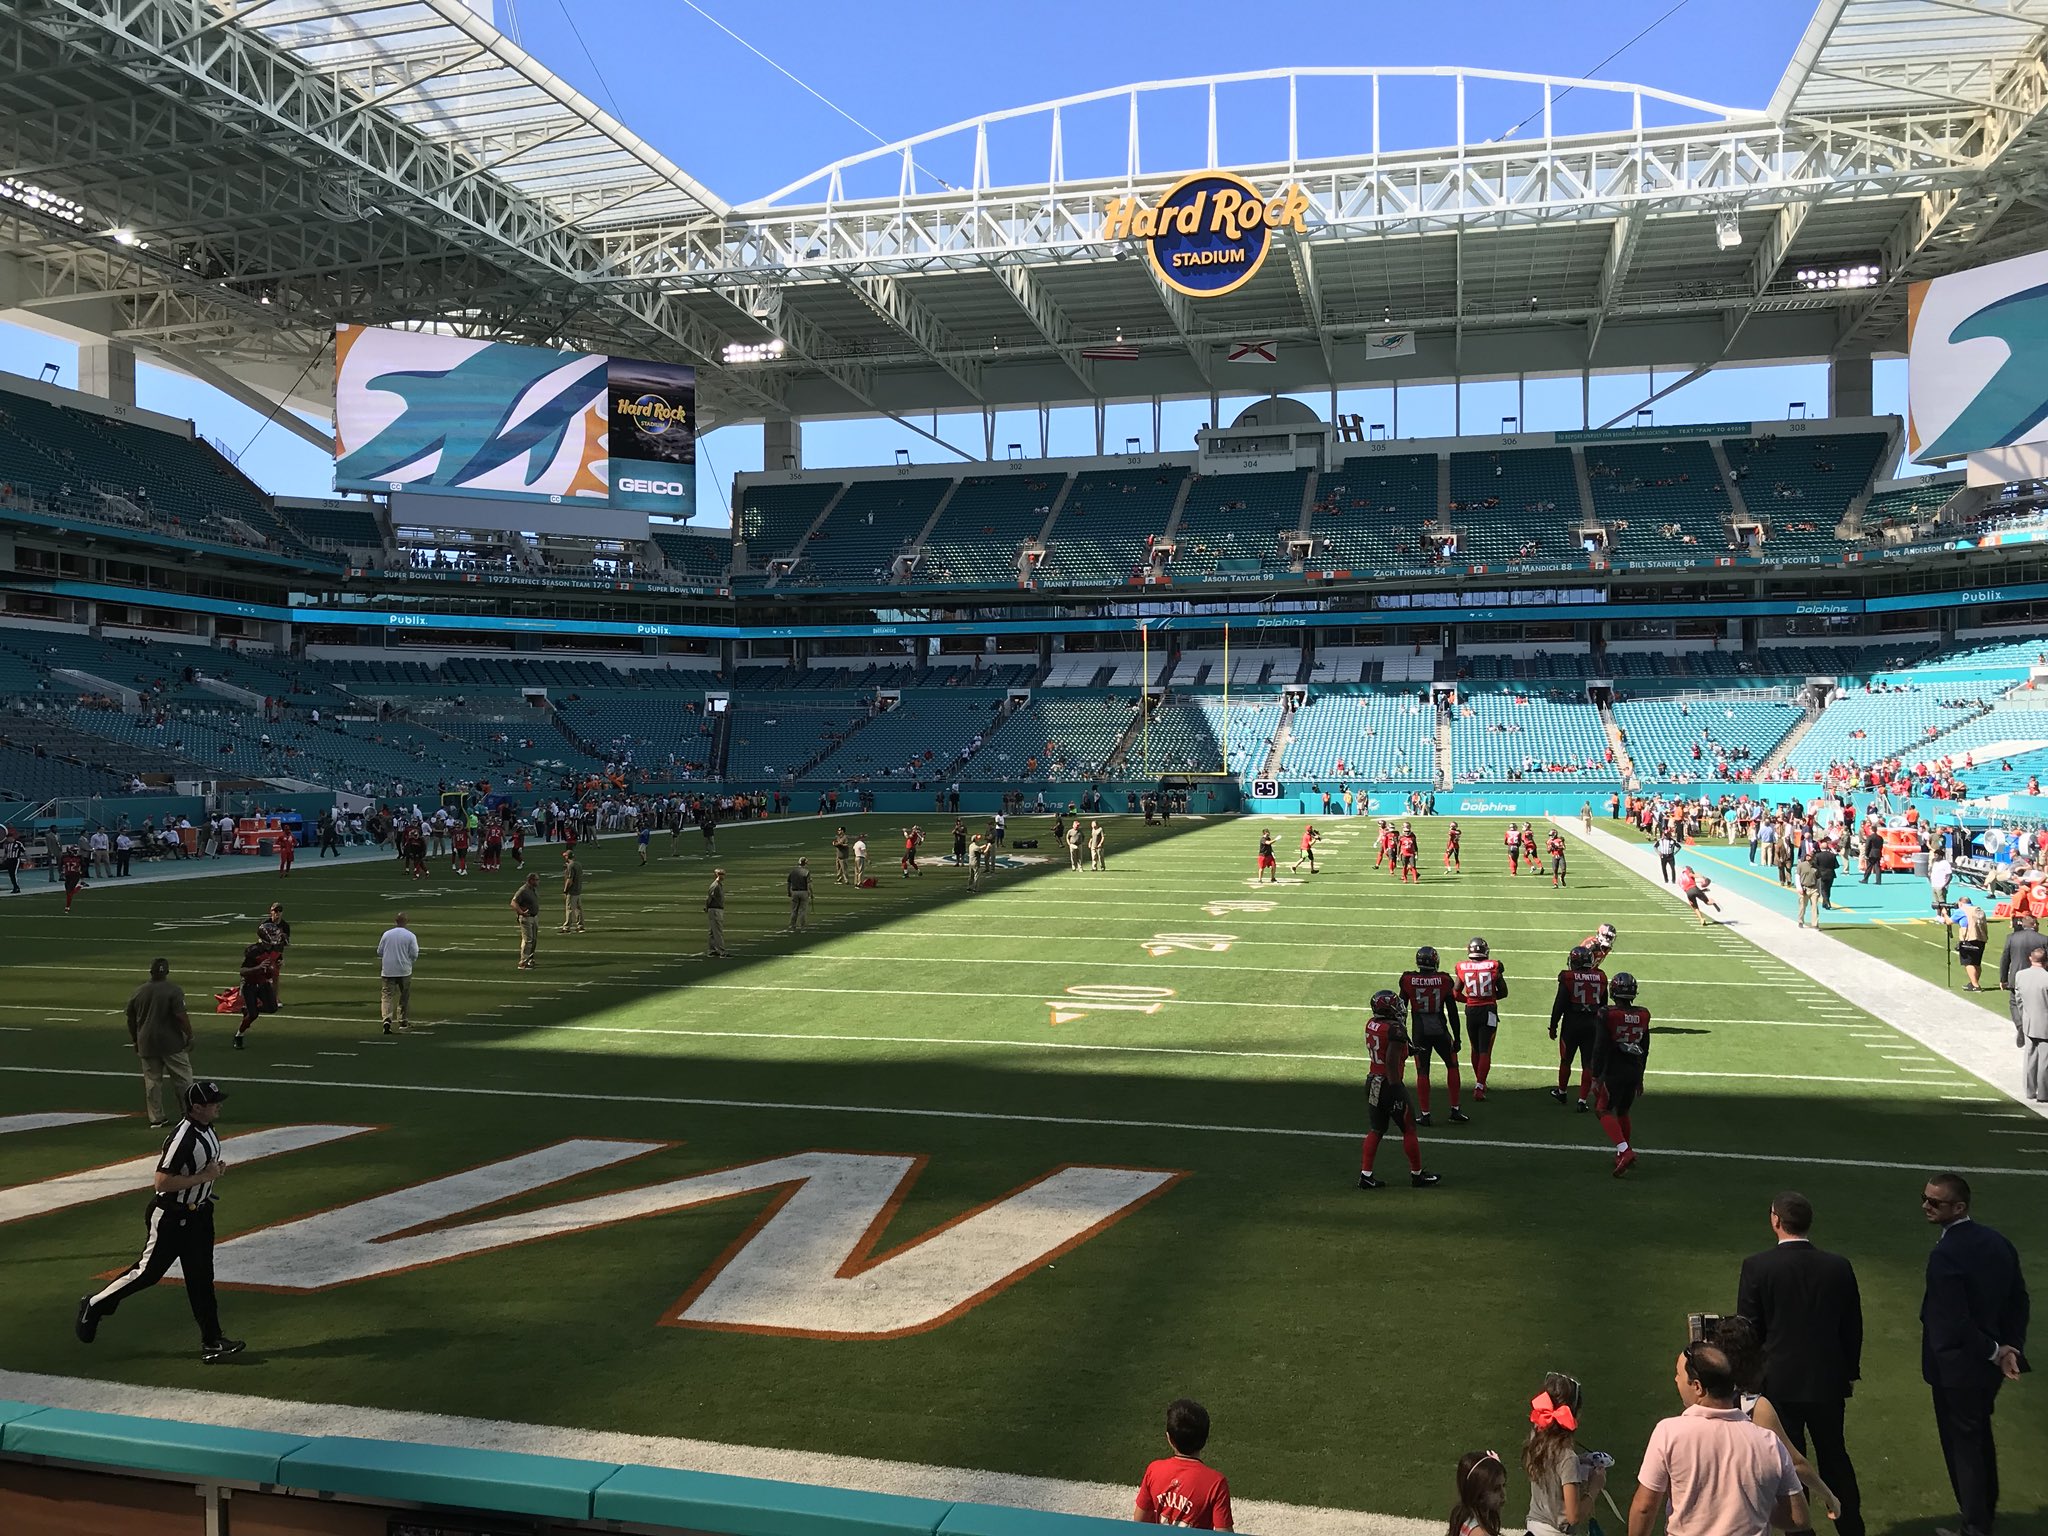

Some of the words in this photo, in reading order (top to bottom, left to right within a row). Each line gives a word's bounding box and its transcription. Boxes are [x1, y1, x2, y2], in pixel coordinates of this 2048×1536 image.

[1104, 191, 1207, 240] Hard
[1210, 183, 1309, 240] Rock
[1172, 248, 1245, 267] STADIUM
[113, 405, 127, 417] 351
[617, 398, 653, 417] Hard
[653, 402, 686, 424] Rock
[640, 420, 666, 428] STADIUM
[1789, 424, 1806, 432] 308
[1920, 475, 1936, 485] 309
[618, 477, 683, 496] GEICO
[321, 499, 340, 509] 352
[1884, 550, 1901, 558] DICK
[1903, 545, 1942, 557] ANDERSON
[1944, 541, 1956, 550] 40
[1629, 561, 1645, 569] BILL
[1647, 560, 1682, 568] STANFILL
[1684, 559, 1696, 567] 84
[1760, 557, 1780, 565] JAKE
[1782, 556, 1808, 564] SCOTT
[1809, 555, 1820, 563] 13
[1373, 569, 1396, 577] ZACH
[1398, 568, 1432, 576] THOMAS
[1434, 567, 1446, 575] 54
[1505, 565, 1519, 573] JIM
[1521, 563, 1560, 572] MANDICH
[1561, 563, 1573, 571] 88
[383, 570, 407, 579] SUPER
[409, 571, 432, 580] BOWL
[1202, 575, 1228, 583] JASON
[1230, 574, 1261, 582] TAYLOR
[1263, 573, 1274, 581] 99
[488, 575, 510, 584] 1972
[511, 577, 539, 585] PERFECT
[541, 578, 570, 588] SEASON
[572, 580, 590, 588] TEAM
[592, 581, 611, 590] 17-0
[1043, 580, 1070, 588] MANNY
[1072, 579, 1110, 587] FERNANDEZ
[1112, 578, 1123, 586] 75
[647, 584, 668, 593] SUPER
[669, 586, 689, 594] BOWL
[1796, 604, 1848, 615] Dolphins
[1257, 618, 1307, 628] Dolphins
[1257, 782, 1274, 795] 25
[1460, 801, 1518, 813] Dolphins
[1140, 932, 1240, 953] 20
[1464, 971, 1493, 997] 58
[1044, 984, 1176, 1016] 10
[1415, 987, 1442, 1013] 51
[1624, 1013, 1640, 1024] BOND
[1156, 1491, 1194, 1515] EVANS
